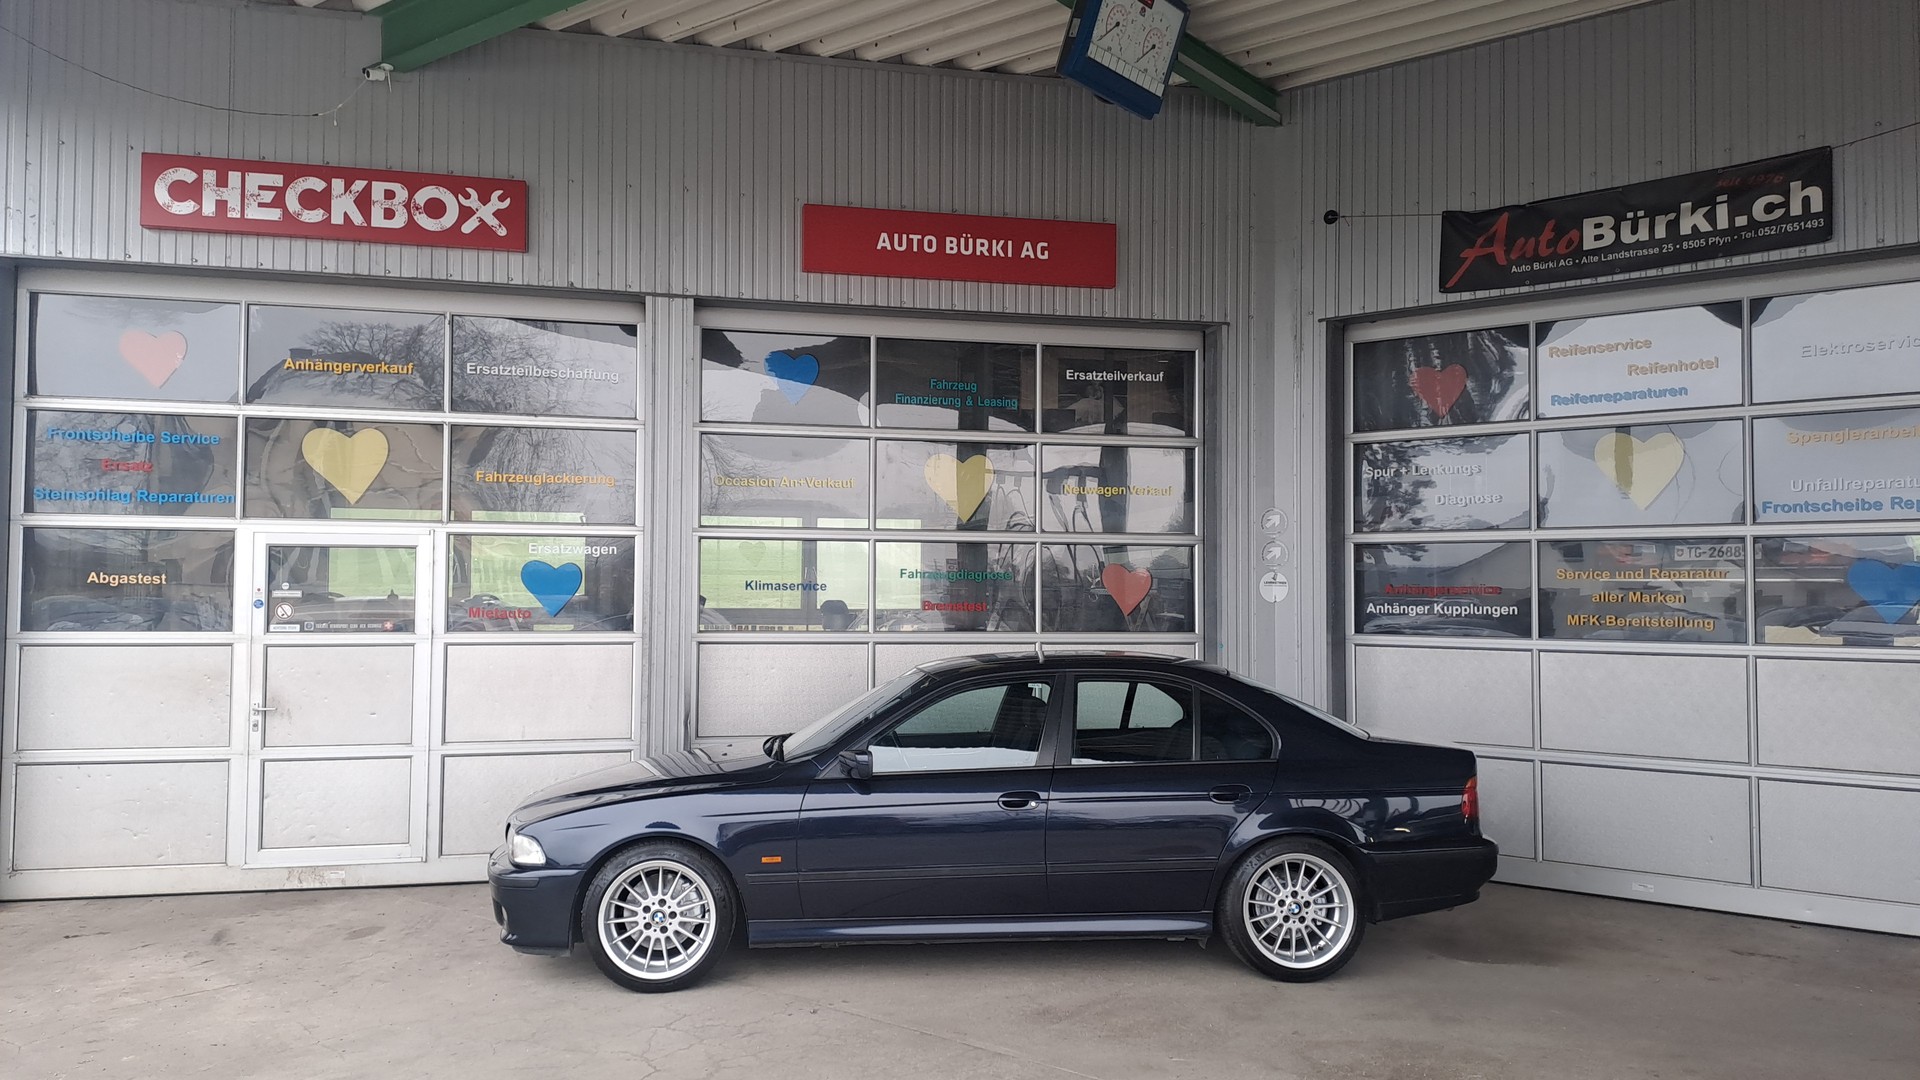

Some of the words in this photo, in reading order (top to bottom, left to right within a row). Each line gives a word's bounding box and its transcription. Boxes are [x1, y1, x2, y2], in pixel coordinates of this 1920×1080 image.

[876, 232, 937, 253] AUTO
[945, 233, 1013, 258] BÜRKI
[1020, 241, 1049, 260] AG
[1511, 264, 1531, 274] Auto
[1533, 261, 1557, 271] Bürki
[1558, 258, 1573, 267] AG
[1581, 255, 1599, 265] Alte
[1601, 246, 1660, 261] Landstrasse
[1662, 244, 1674, 252] 25
[1682, 238, 1706, 250] 8505
[1708, 235, 1731, 247] Pfyn
[1549, 338, 1652, 358] Reifenservice
[284, 358, 414, 375] Anhängerverkauf
[466, 362, 619, 384] Ersatzteilbeschaffung
[1627, 355, 1719, 376] Reifenhotel
[1066, 369, 1164, 382] Ersatzteilverkauf
[930, 379, 977, 392] Fahrzeug
[895, 393, 961, 408] Finanzierung
[966, 396, 973, 406] &
[978, 396, 1018, 410] Leasing
[1551, 386, 1689, 406] Reifenreparaturen
[48, 426, 155, 444] Frontscheibe
[160, 431, 220, 445] Service
[1787, 425, 1920, 446] Spenglerarbei
[102, 458, 153, 473] Ersatz
[1365, 465, 1396, 480] Spur
[1400, 467, 1408, 476] +
[1412, 463, 1482, 476] Lenkungs
[475, 470, 615, 487] Fahrzeuglackierung
[714, 474, 776, 487] Occasion
[33, 487, 131, 504] Steinschlag
[136, 489, 236, 504] Reparaturen
[1063, 485, 1126, 497] Neuwagen
[1127, 485, 1173, 497] Verkauf
[1435, 493, 1503, 507] Diagnose
[1762, 497, 1884, 514] Frontscheibe
[528, 543, 617, 557] Ersatzwagen
[87, 571, 167, 587] Abgastest
[900, 568, 1013, 583] Fahrzeugdiagnose
[1556, 568, 1611, 580] Service
[1616, 568, 1644, 580] und
[1650, 569, 1729, 582] Reparatur
[745, 580, 827, 591] Klimaservice
[922, 600, 988, 611] Bremstest
[1592, 592, 1624, 603] aller
[1628, 592, 1685, 604] Marken
[468, 607, 532, 619] Mietauto
[1366, 602, 1429, 617] Anhänger
[1434, 602, 1518, 617] Kupplungen
[1567, 614, 1715, 630] MFK-Bereitstellung
